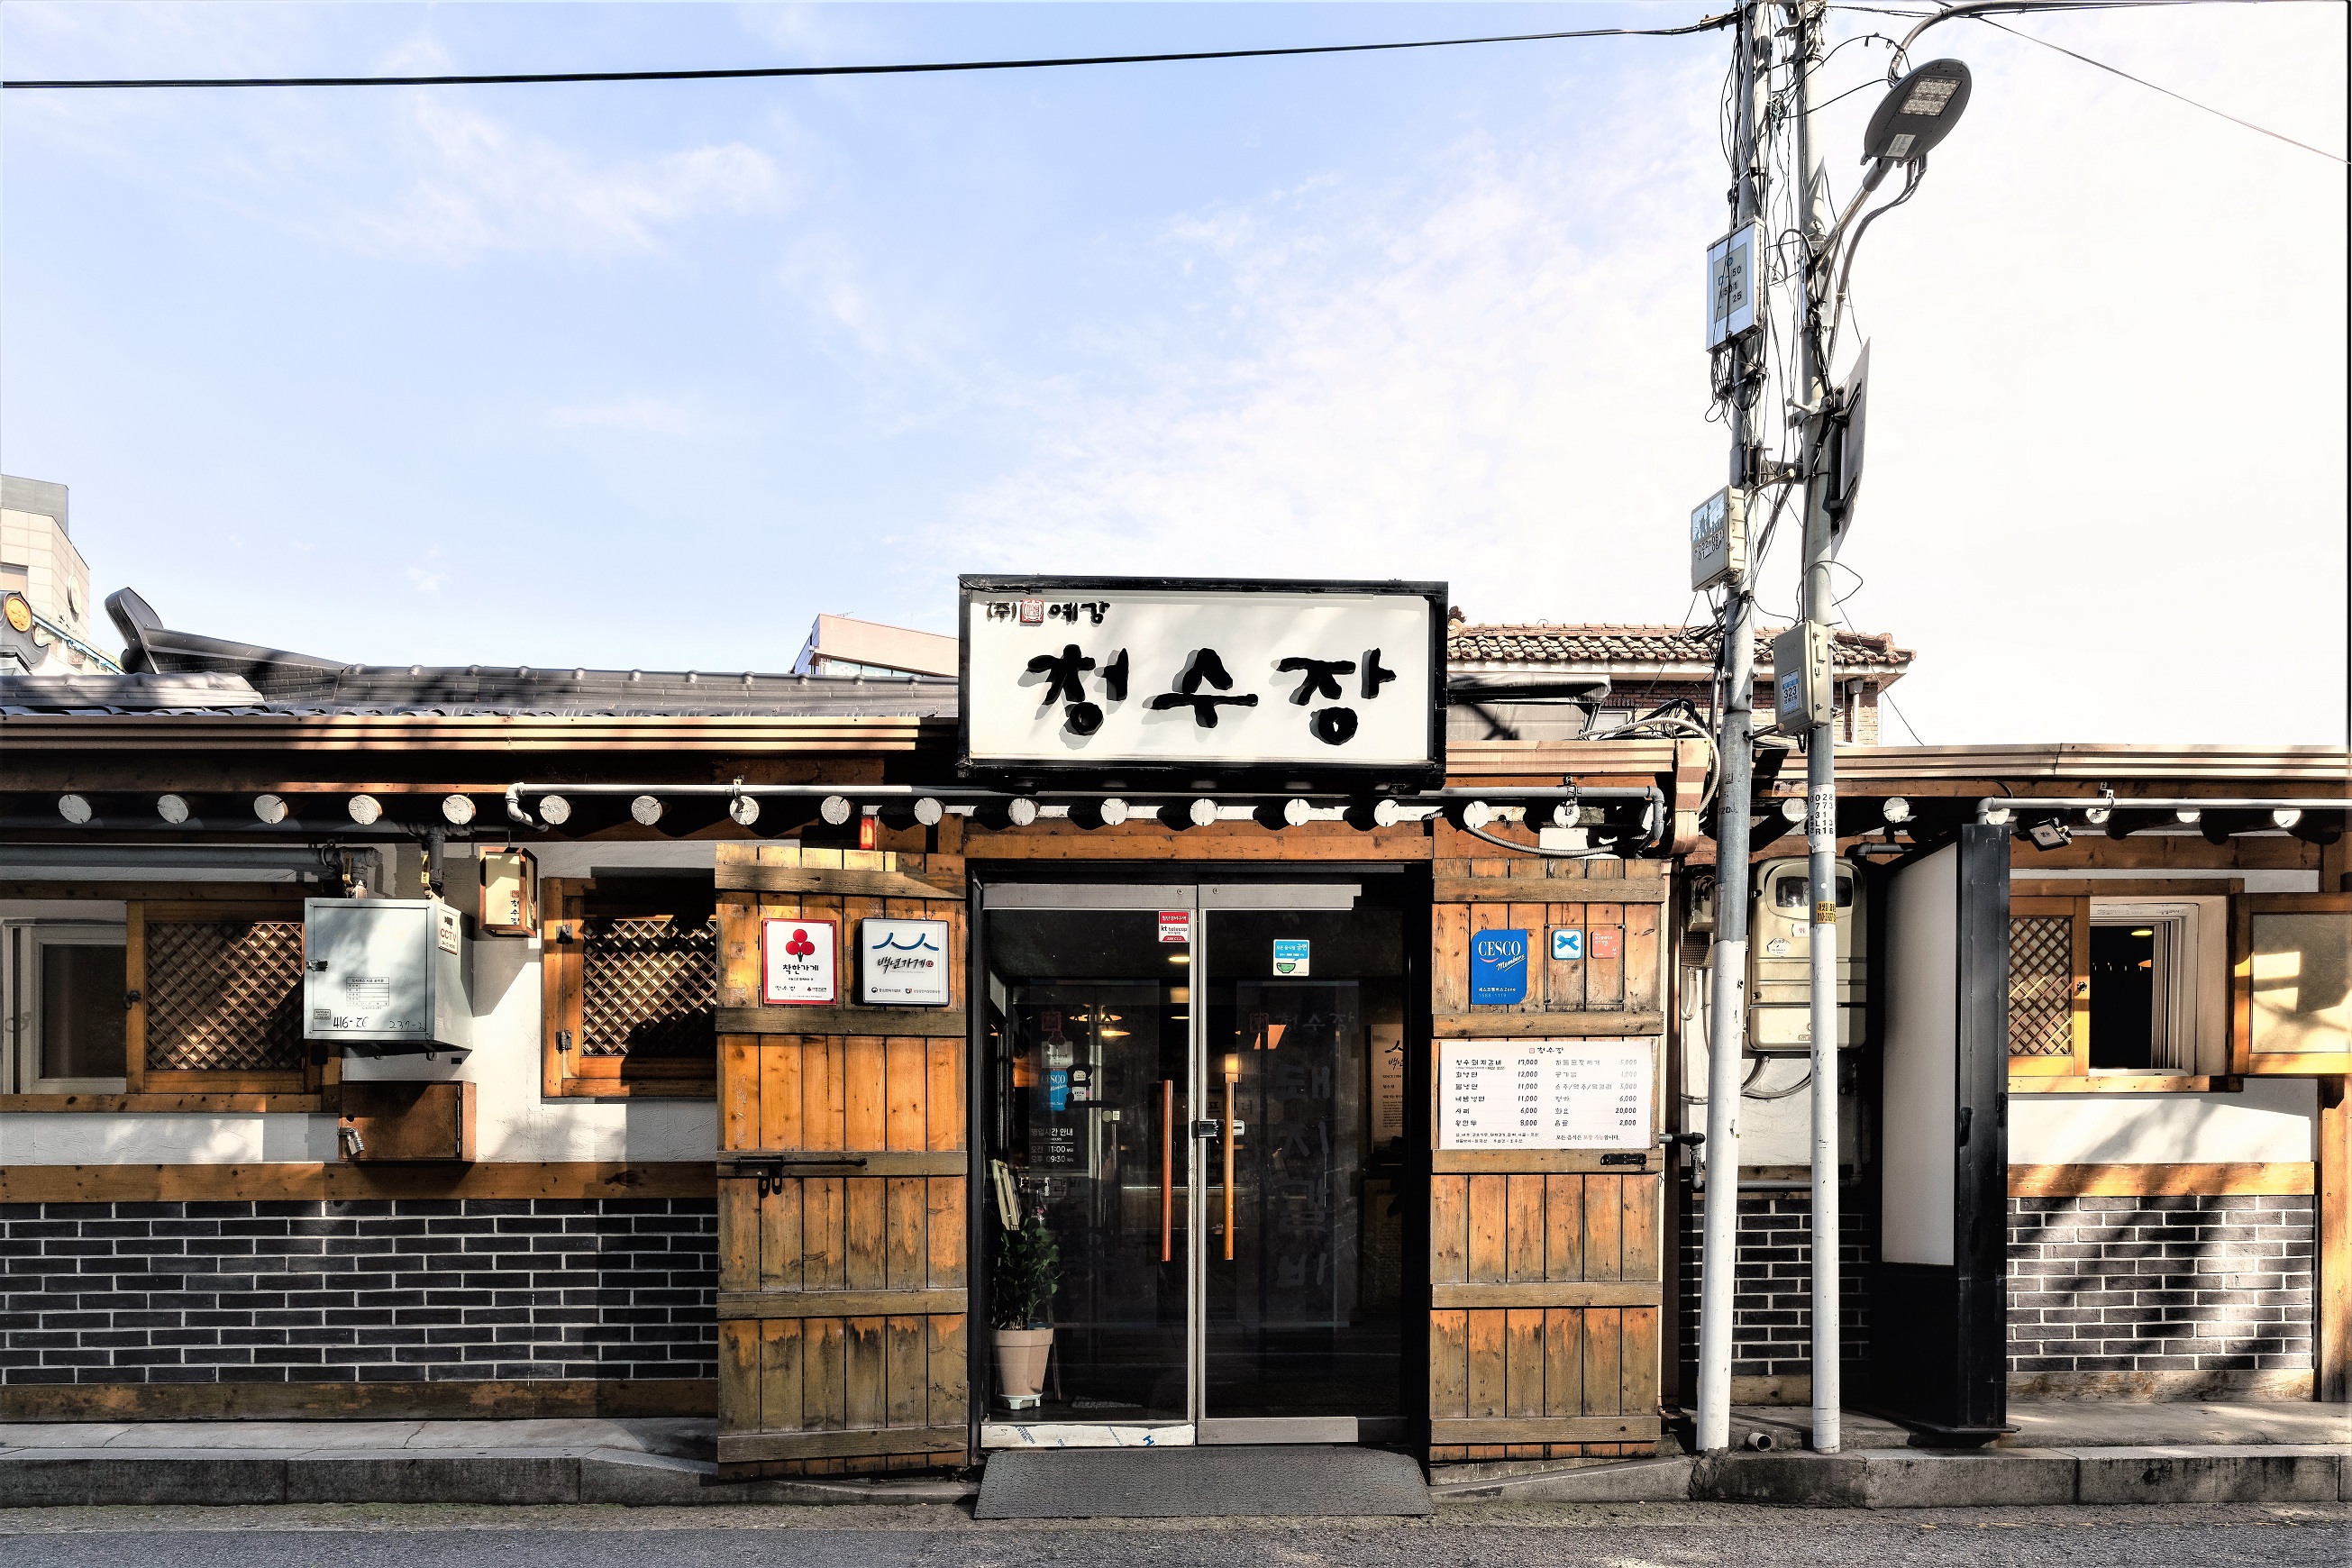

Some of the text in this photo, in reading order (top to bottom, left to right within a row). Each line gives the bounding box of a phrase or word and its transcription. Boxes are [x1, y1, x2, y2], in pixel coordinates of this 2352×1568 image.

[1048, 600, 1110, 625] 예강
[1027, 643, 1397, 746] 청수장
[1783, 685, 1797, 699] 323
[510, 899, 520, 925] 청수장
[441, 928, 457, 943] CCTV
[1296, 944, 1308, 952] 금연
[1478, 940, 1521, 956] CESCO
[782, 963, 819, 975] 착한가게
[877, 955, 926, 974] 백년가게
[1496, 953, 1525, 971] Members
[1536, 1046, 1564, 1054] 청수장
[1615, 1107, 1637, 1115] 20,000
[1031, 1127, 1073, 1136] 영업시간 안내
[1031, 1145, 1044, 1153] 오전
[1047, 1145, 1066, 1153] 11:00
[1031, 1155, 1044, 1163] 오후
